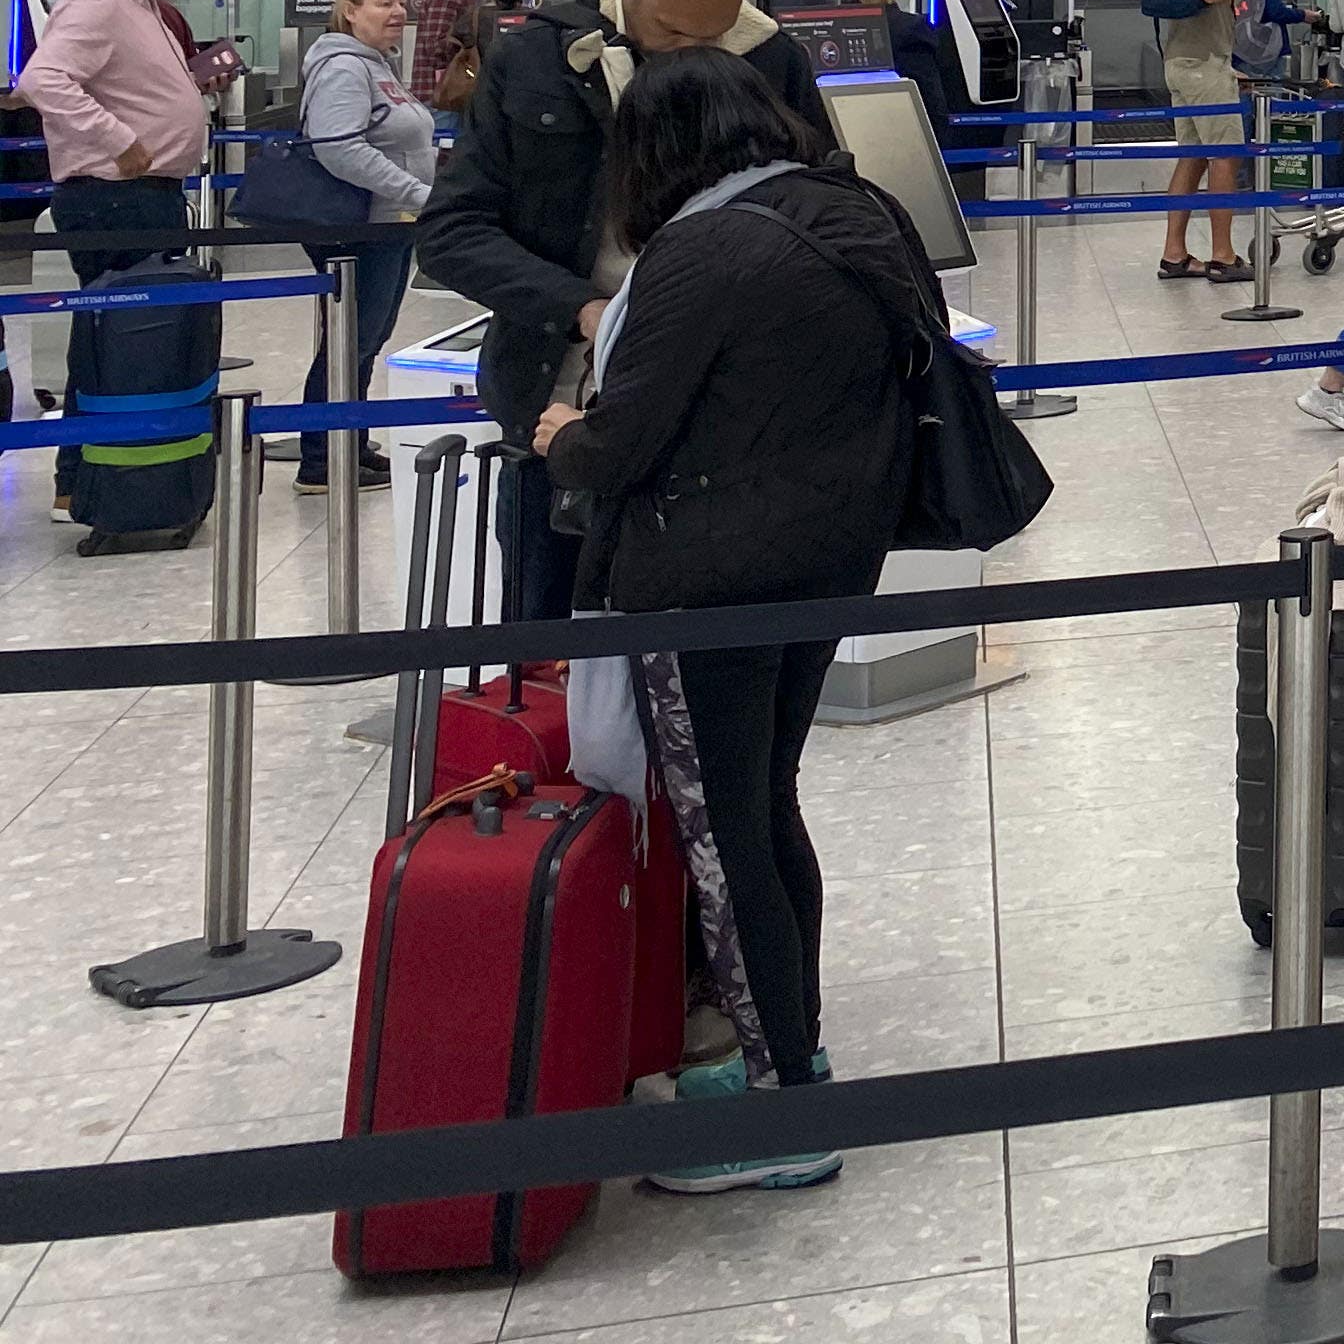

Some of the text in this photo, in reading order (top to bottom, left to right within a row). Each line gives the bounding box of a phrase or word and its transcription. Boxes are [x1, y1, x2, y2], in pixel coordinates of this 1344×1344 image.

[1310, 192, 1336, 200] BRITISH
[1073, 202, 1101, 210] BRITISH
[67, 292, 149, 306] BRITISH AIRWAYS
[1277, 352, 1317, 363] BRITISH
